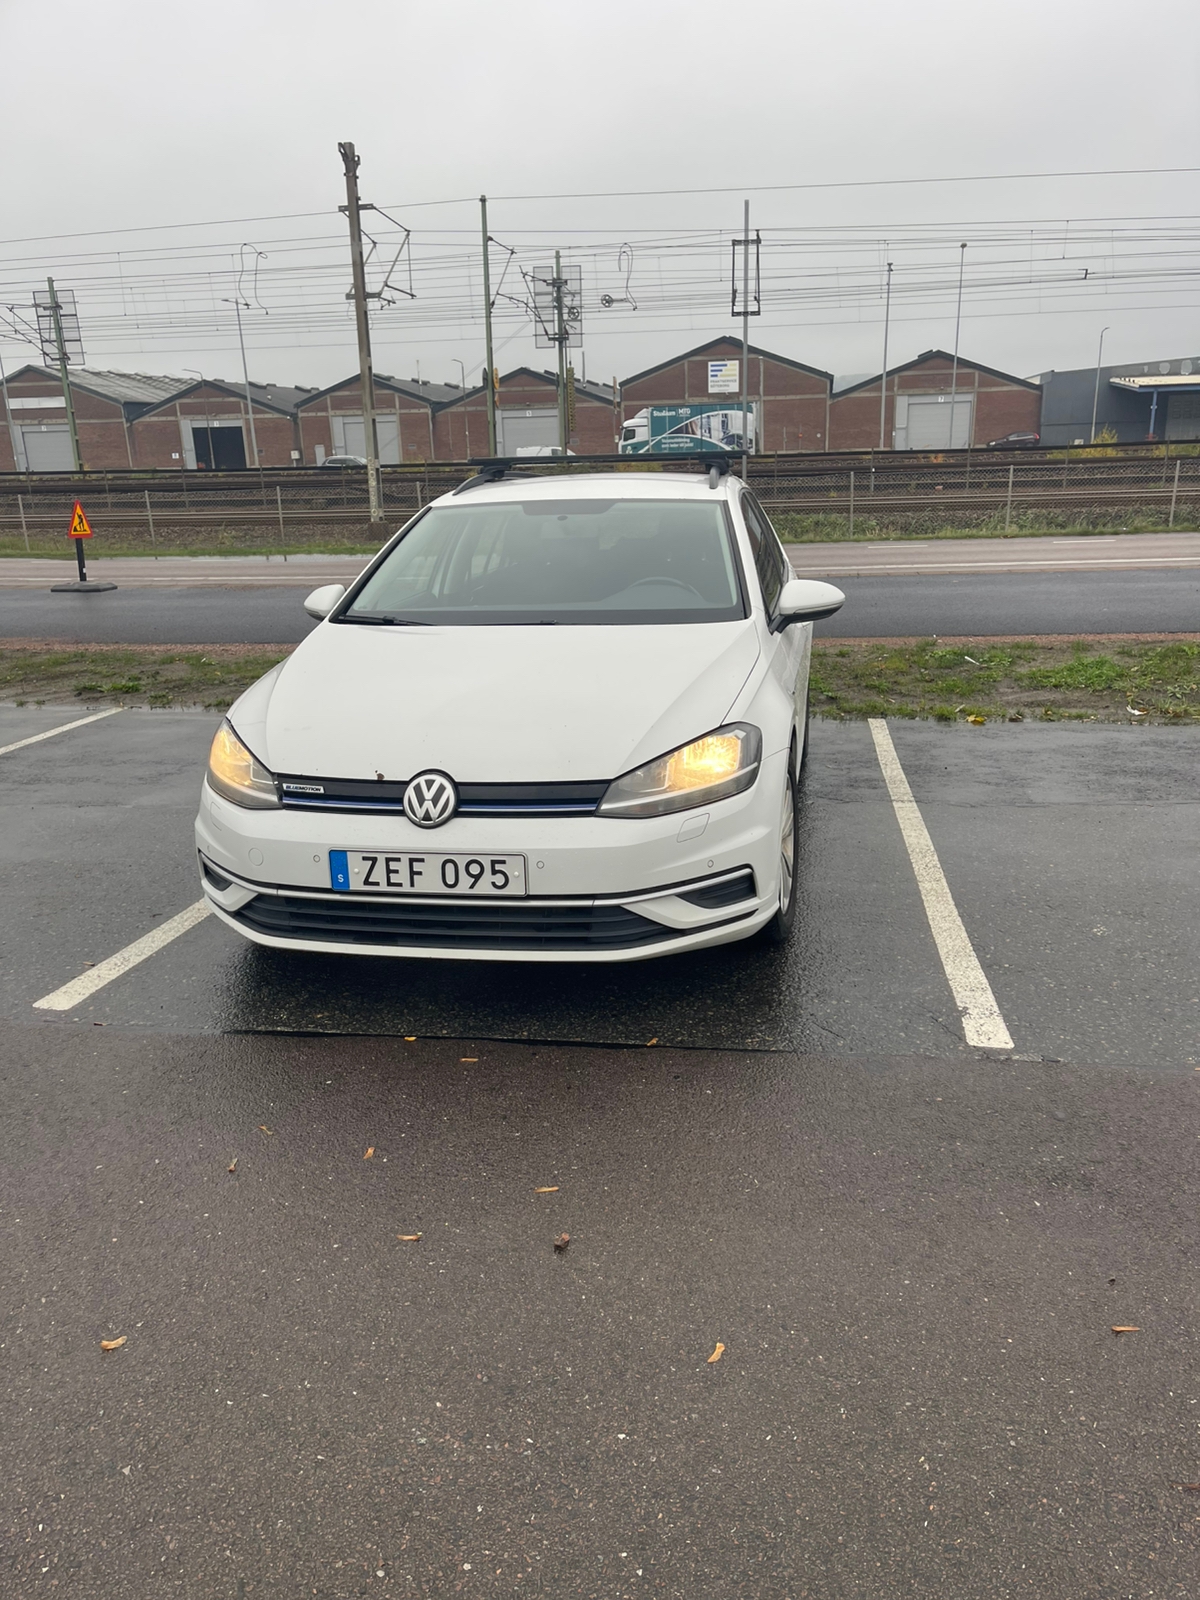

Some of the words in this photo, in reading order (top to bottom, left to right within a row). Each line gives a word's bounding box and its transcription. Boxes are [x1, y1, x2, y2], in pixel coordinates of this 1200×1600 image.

[337, 874, 344, 883] S
[361, 856, 426, 888] ZEF
[441, 858, 510, 890] 095
